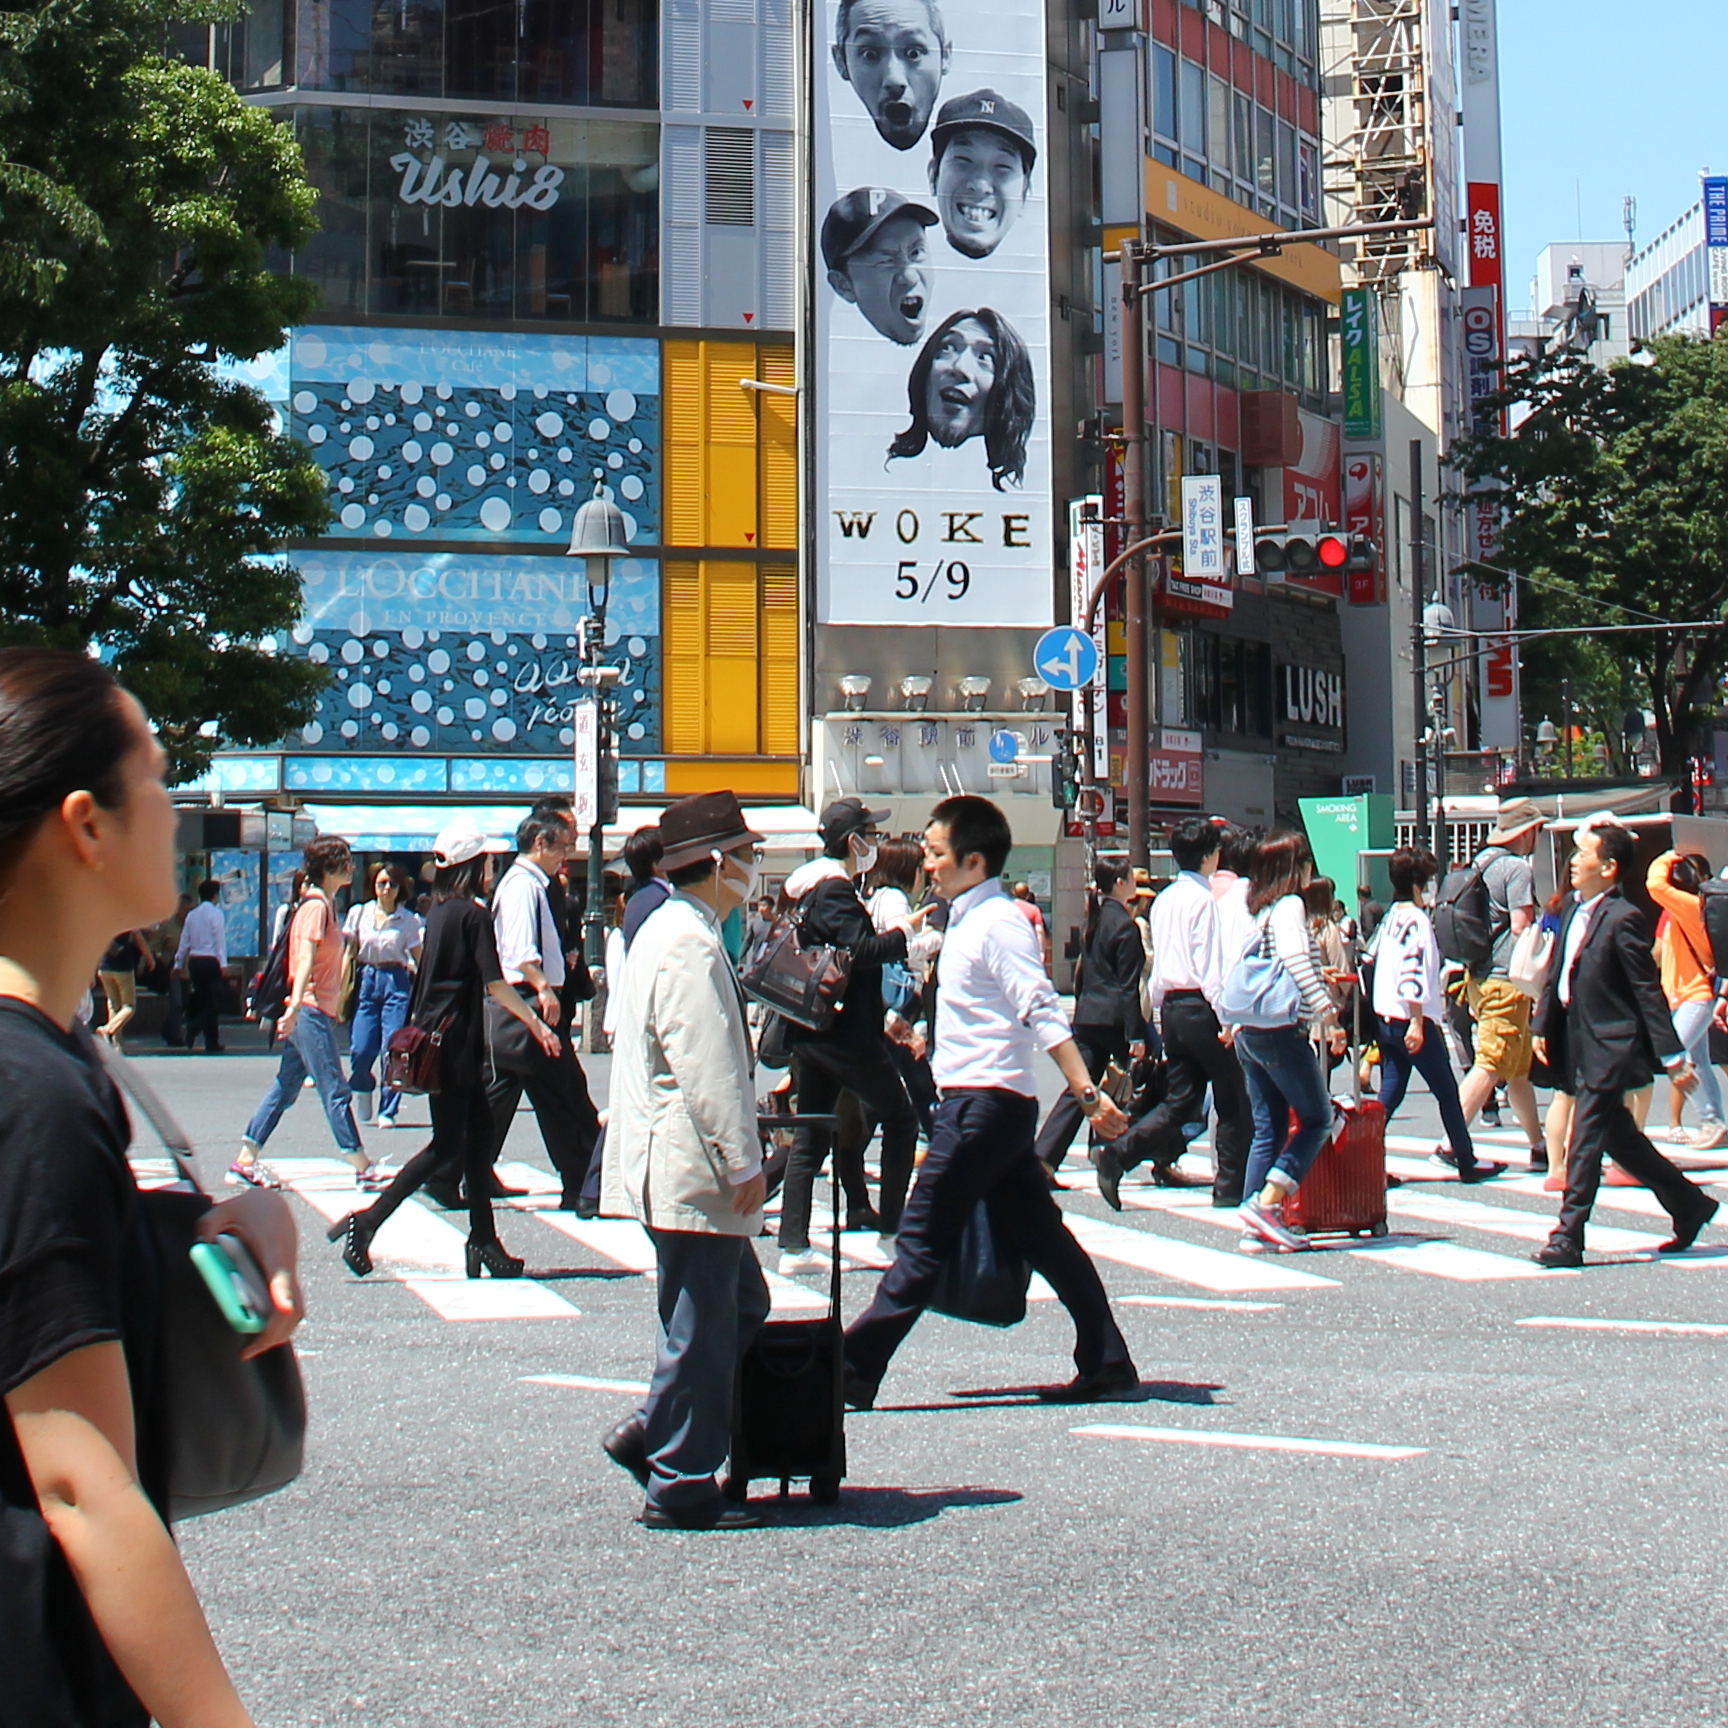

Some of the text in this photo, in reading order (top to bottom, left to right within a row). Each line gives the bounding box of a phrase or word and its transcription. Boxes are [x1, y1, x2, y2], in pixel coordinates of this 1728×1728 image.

[1472, 209, 1496, 260] 免税
[1708, 186, 1727, 242] THE PRIME
[1188, 497, 1197, 535] Shibuya
[1198, 484, 1218, 568] 渋谷駅前
[894, 559, 971, 604] 5/9
[384, 610, 547, 627] EN PROVENCE
[1286, 665, 1342, 727] LUSH
[1316, 804, 1356, 813] SMOKING
